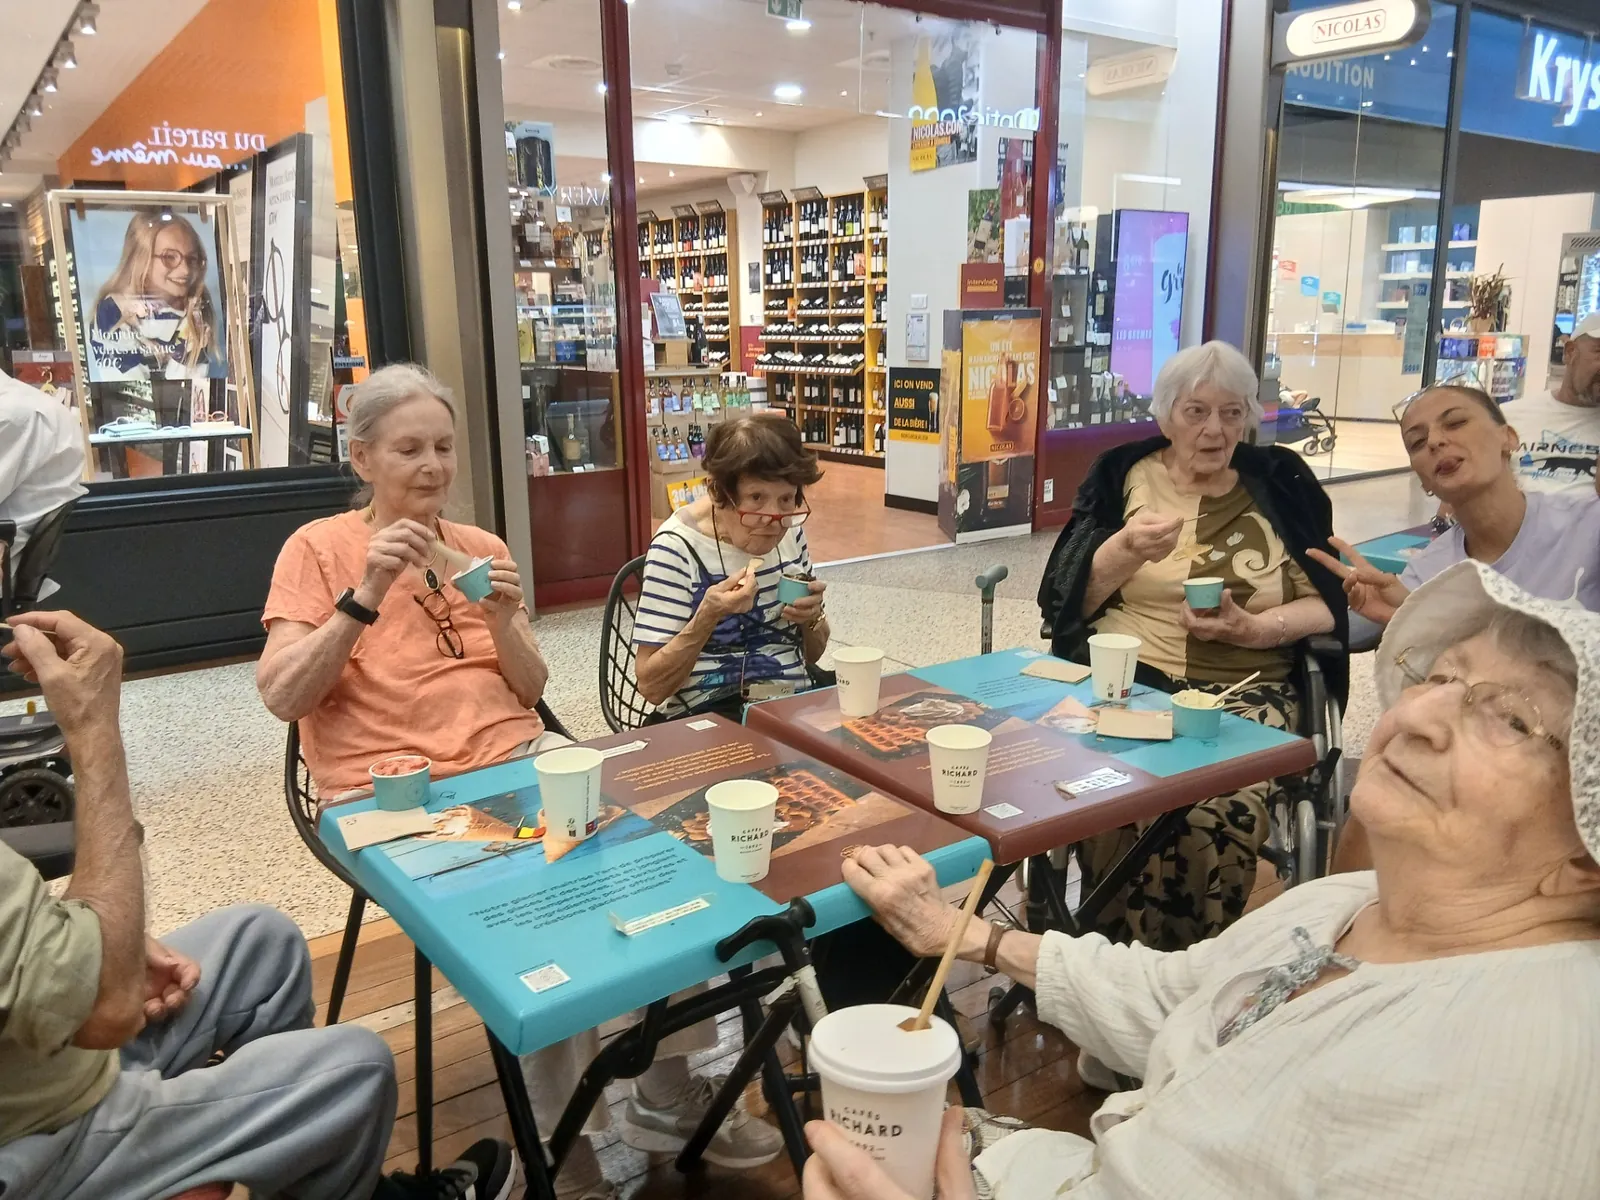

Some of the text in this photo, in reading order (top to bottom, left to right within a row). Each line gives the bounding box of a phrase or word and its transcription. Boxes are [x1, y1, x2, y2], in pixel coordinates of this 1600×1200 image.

[1316, 13, 1383, 39] NICOLAS
[969, 362, 1036, 392] NICOLAS
[894, 380, 934, 390] ICI ON VEND
[894, 397, 915, 409] AUSSI
[893, 417, 902, 427] DE
[902, 418, 910, 427] LA
[941, 769, 978, 778] RICHARD
[731, 829, 769, 842] RICHARD
[830, 1108, 902, 1137] RICHARD
